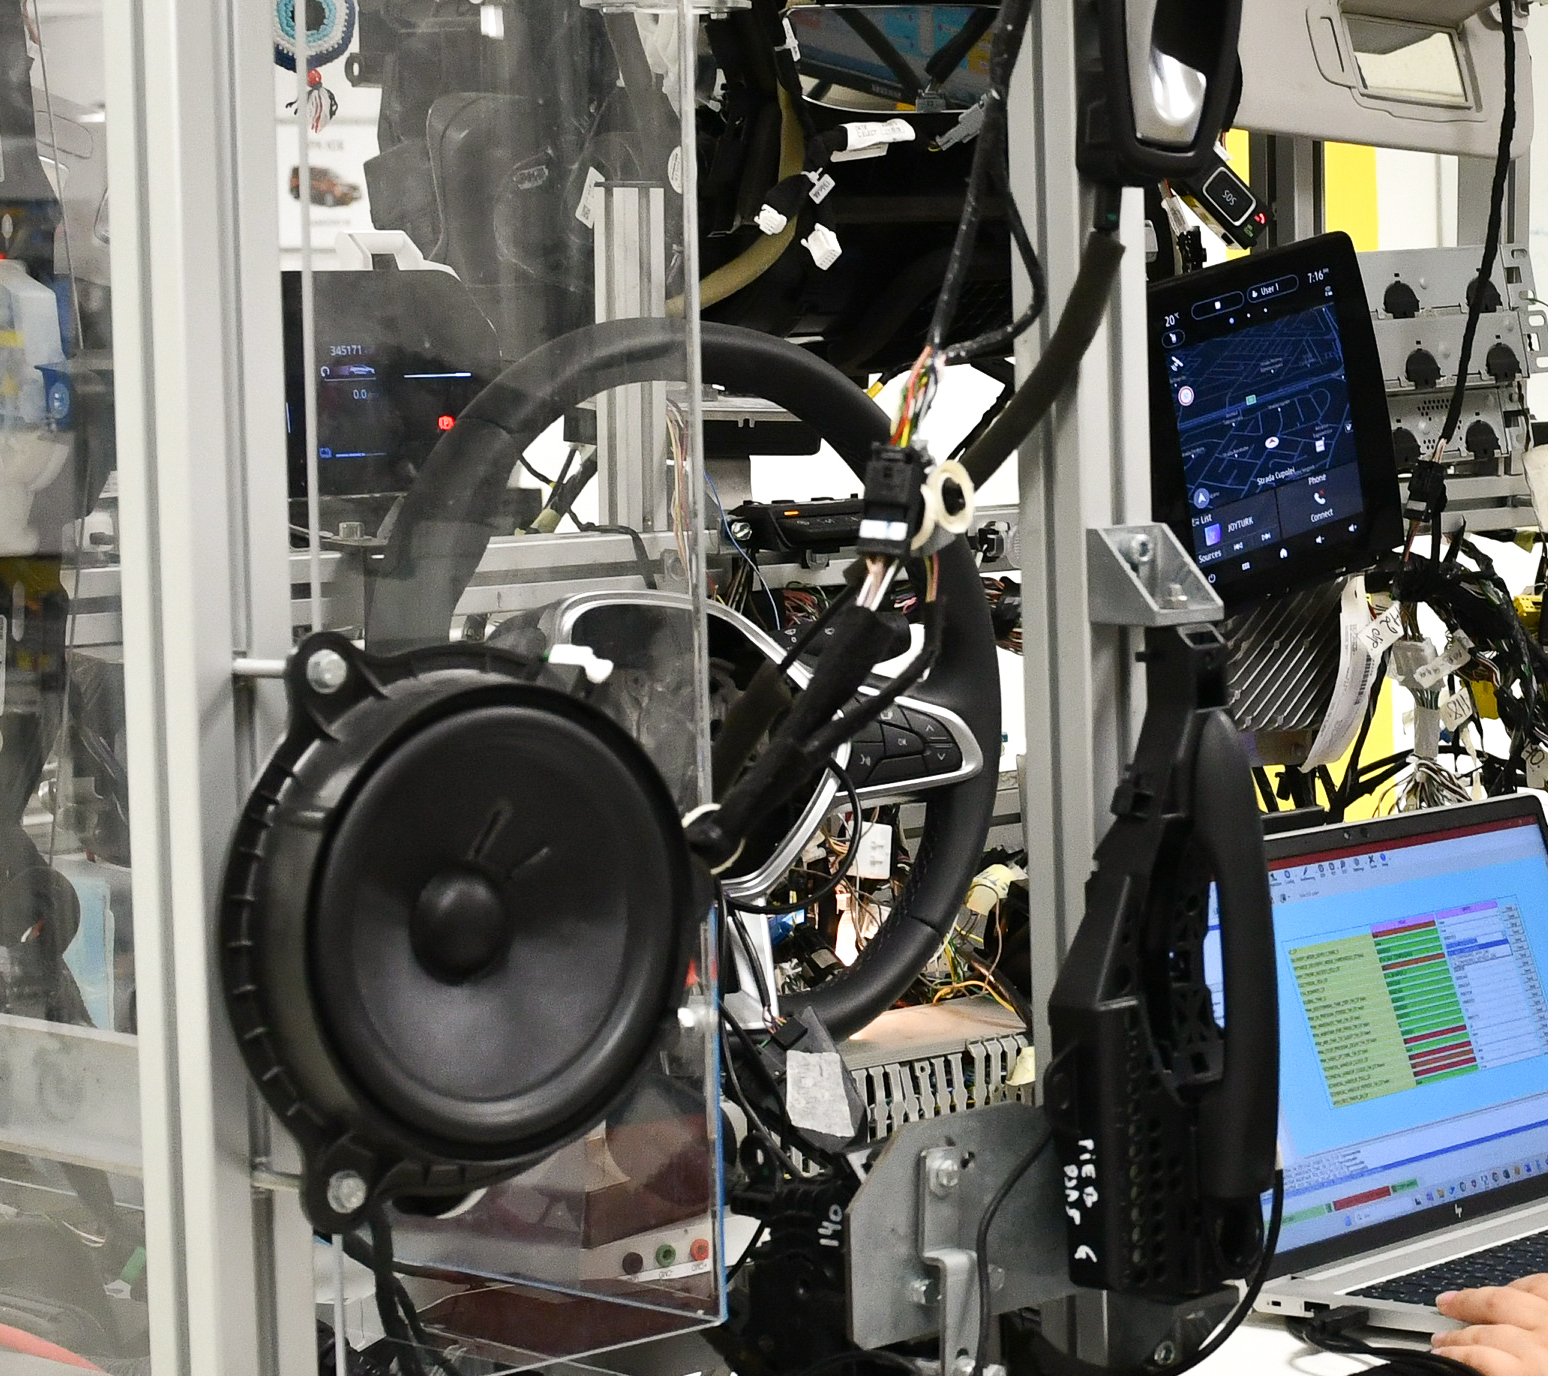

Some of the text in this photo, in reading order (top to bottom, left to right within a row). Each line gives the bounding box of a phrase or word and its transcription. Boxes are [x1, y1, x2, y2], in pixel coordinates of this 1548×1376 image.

[1221, 188, 1238, 206] SOS
[1307, 270, 1323, 284] 7:16
[1260, 283, 1274, 295] User
[1308, 473, 1327, 485] Phone
[1200, 513, 1213, 524] List
[1310, 508, 1334, 523] Connect
[1227, 516, 1254, 533] JOYTURK
[1198, 549, 1222, 563] Sources
